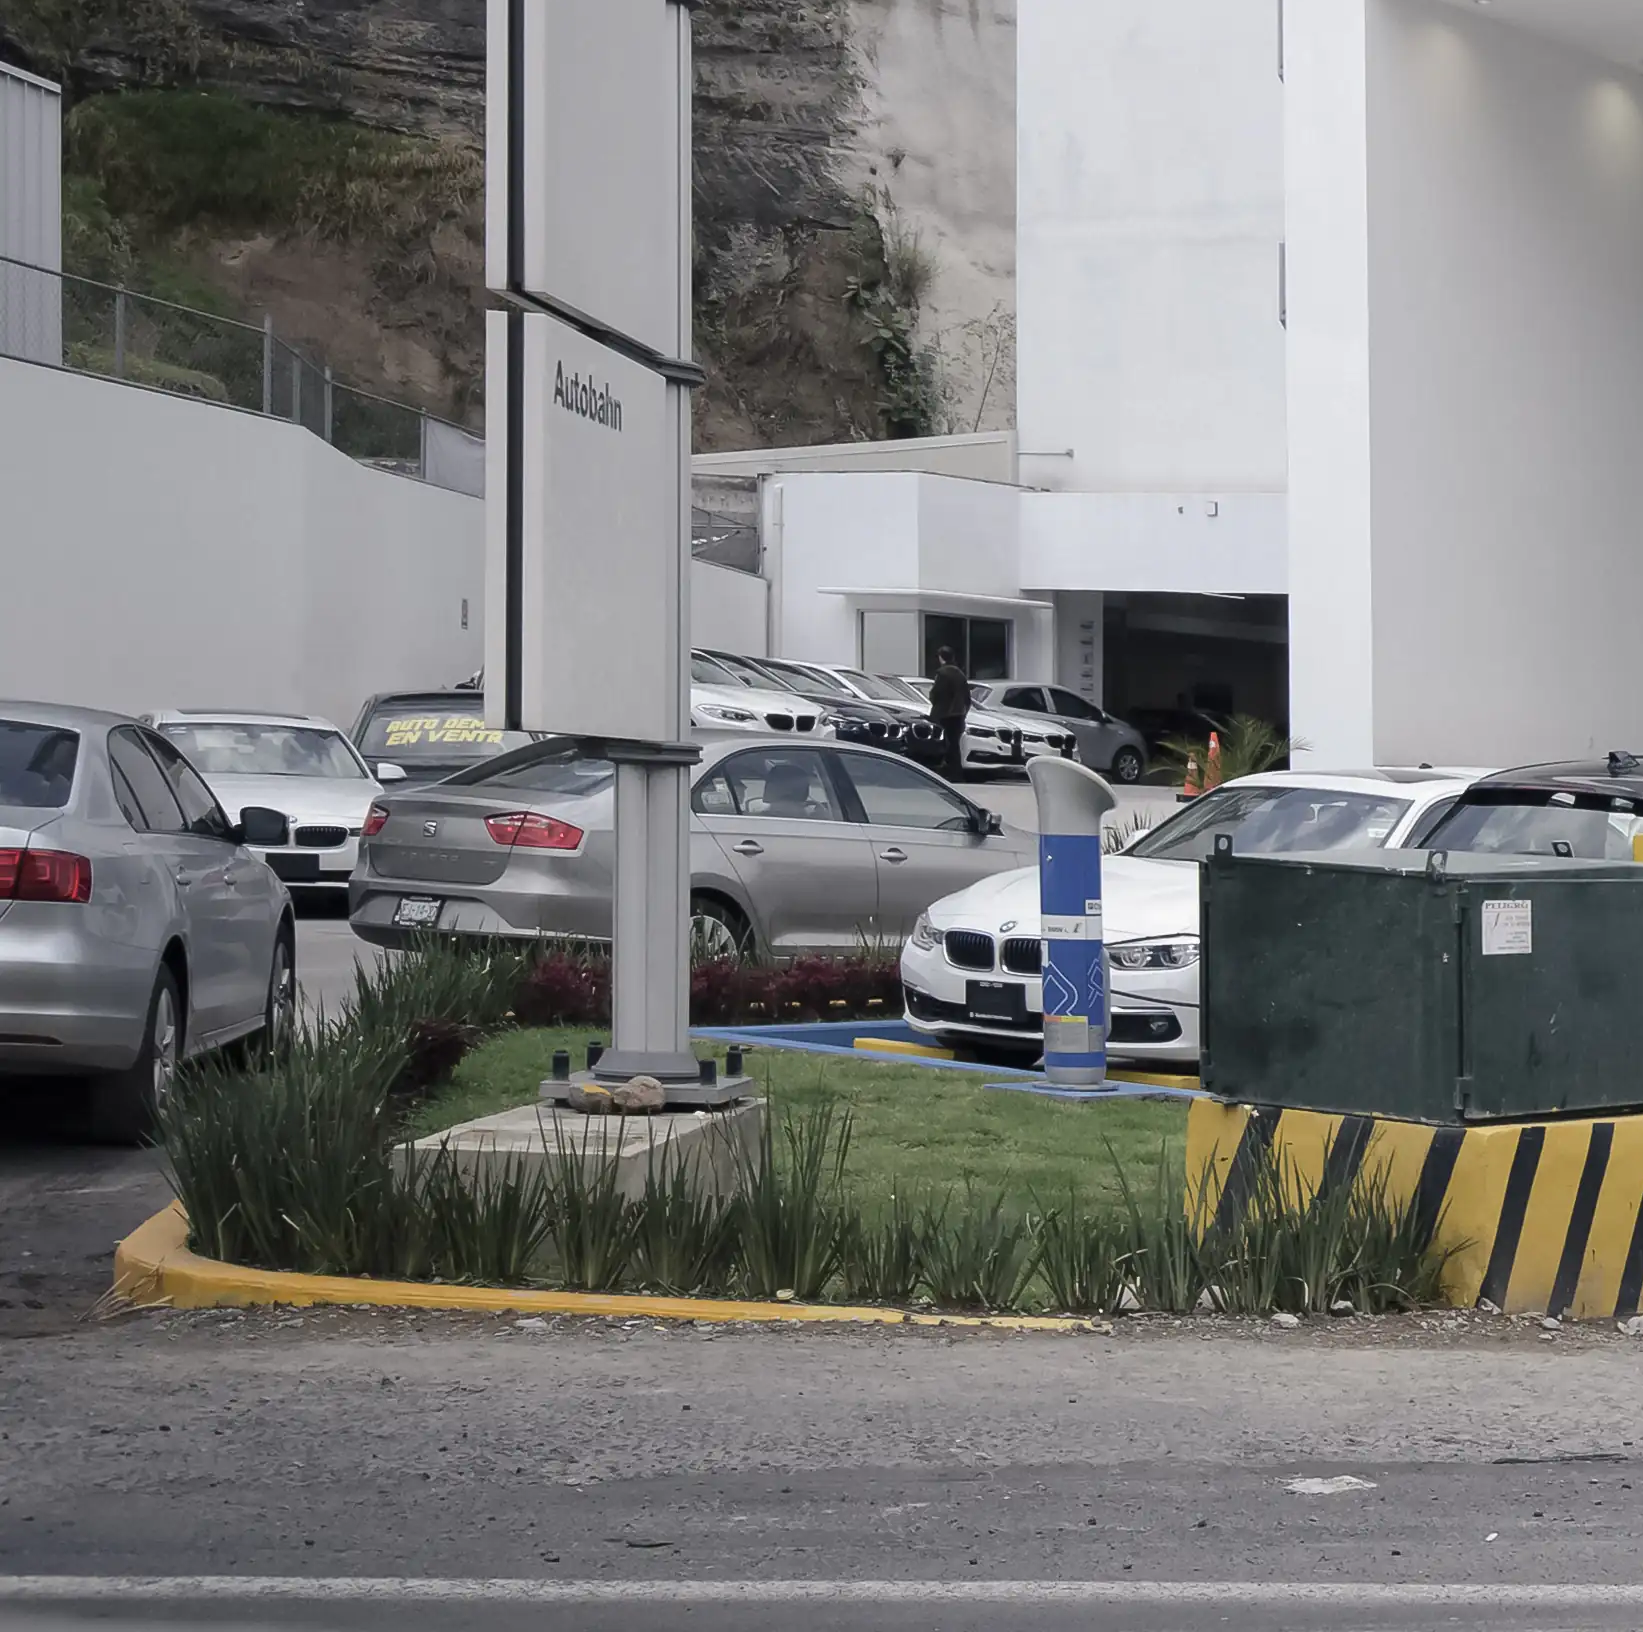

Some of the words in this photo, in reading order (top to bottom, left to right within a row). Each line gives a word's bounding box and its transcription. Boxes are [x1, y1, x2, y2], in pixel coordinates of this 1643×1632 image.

[554, 360, 622, 432] Autobahn
[386, 718, 439, 733] AUTO
[442, 718, 485, 729] DEM
[386, 730, 422, 746] EN
